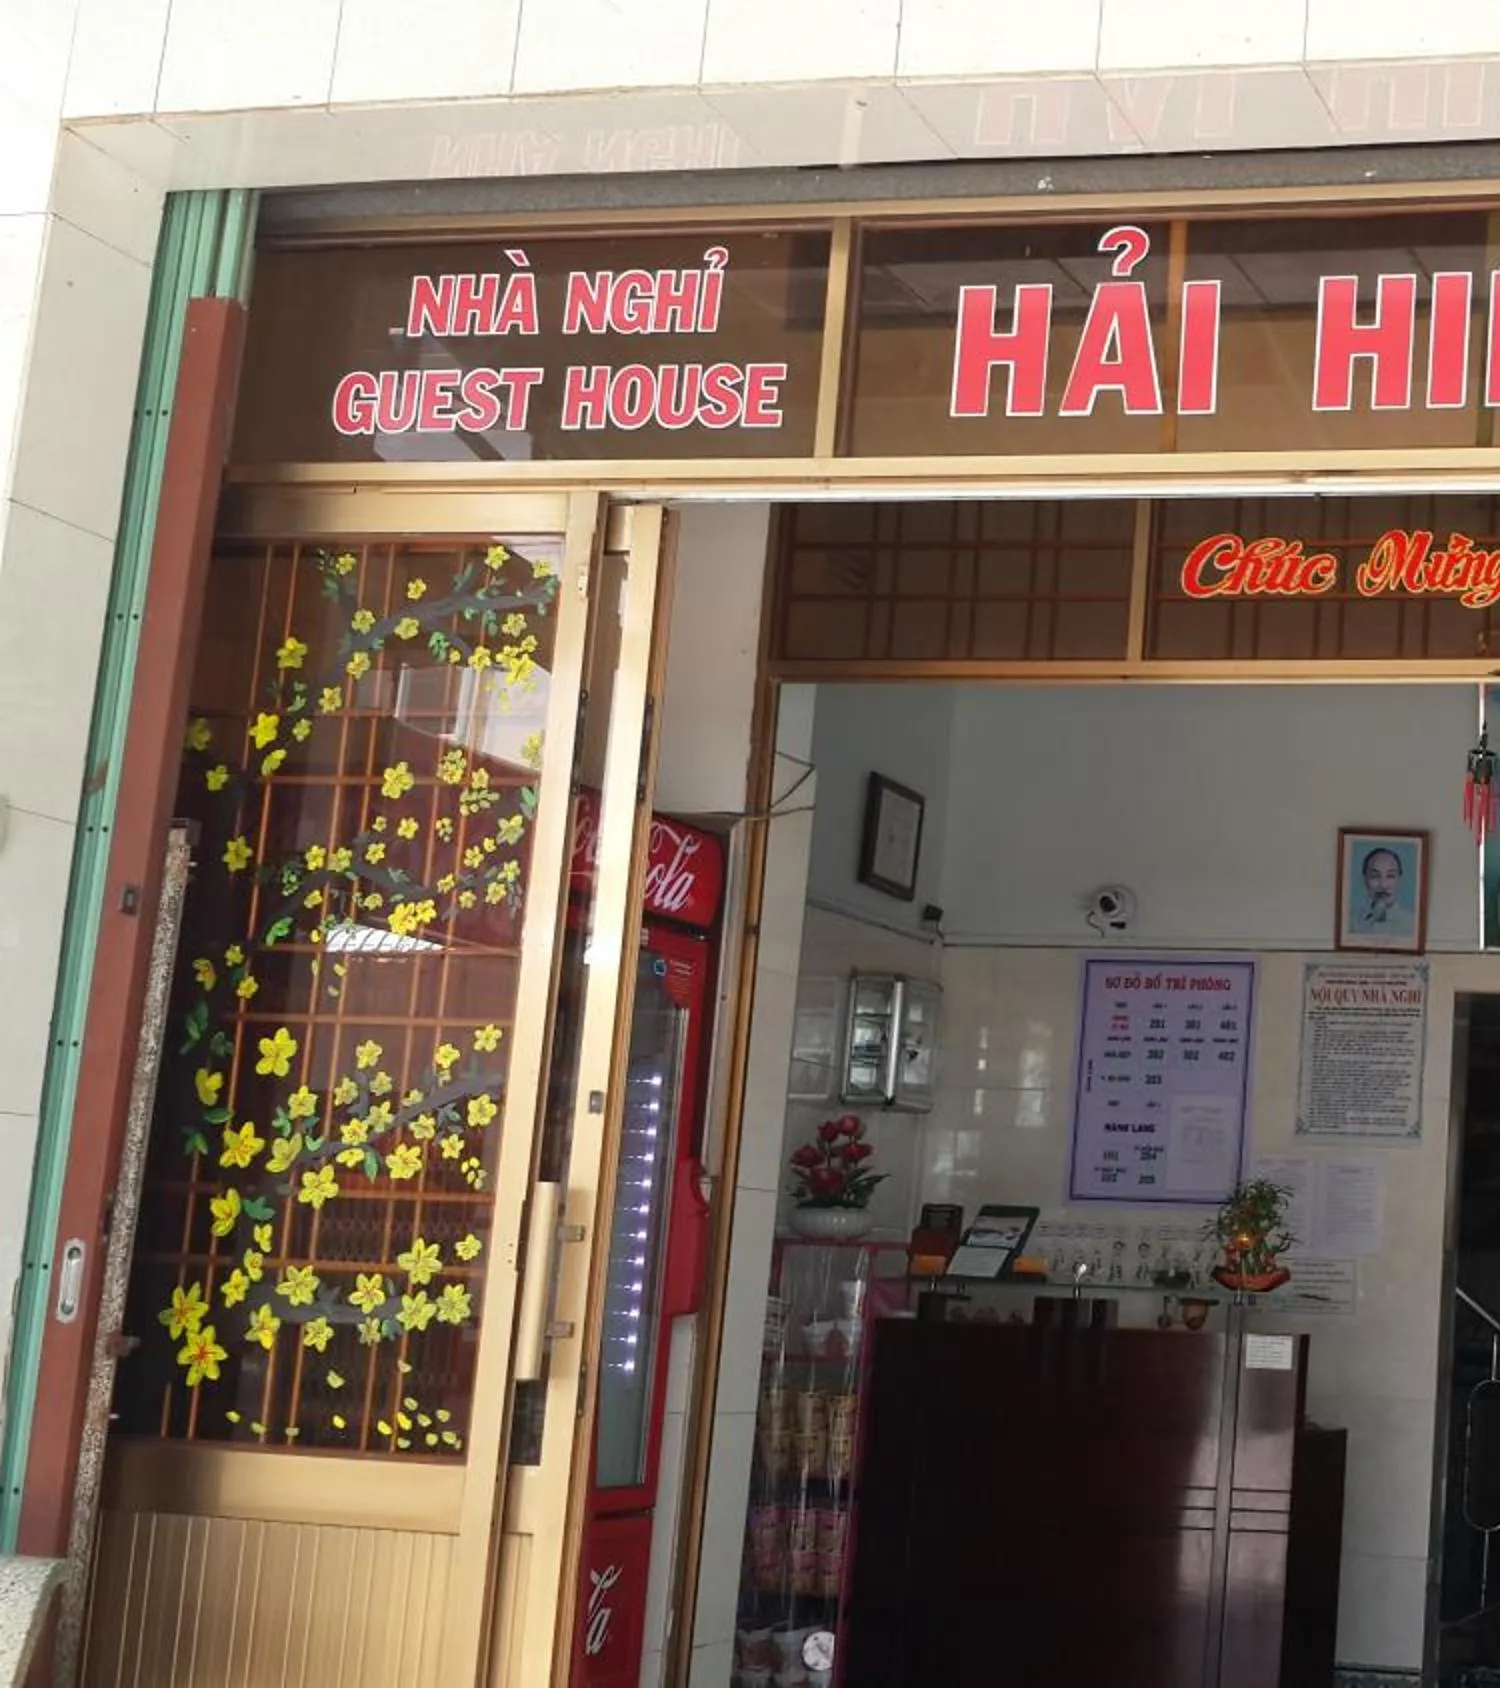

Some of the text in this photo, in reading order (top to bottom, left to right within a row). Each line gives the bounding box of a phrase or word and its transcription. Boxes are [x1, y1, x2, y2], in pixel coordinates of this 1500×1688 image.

[406, 246, 730, 337] NHÀ NGHỈ
[949, 225, 1222, 418] HẢI
[332, 362, 788, 435] GUEST HOUSE
[1181, 533, 1337, 598] Chúc
